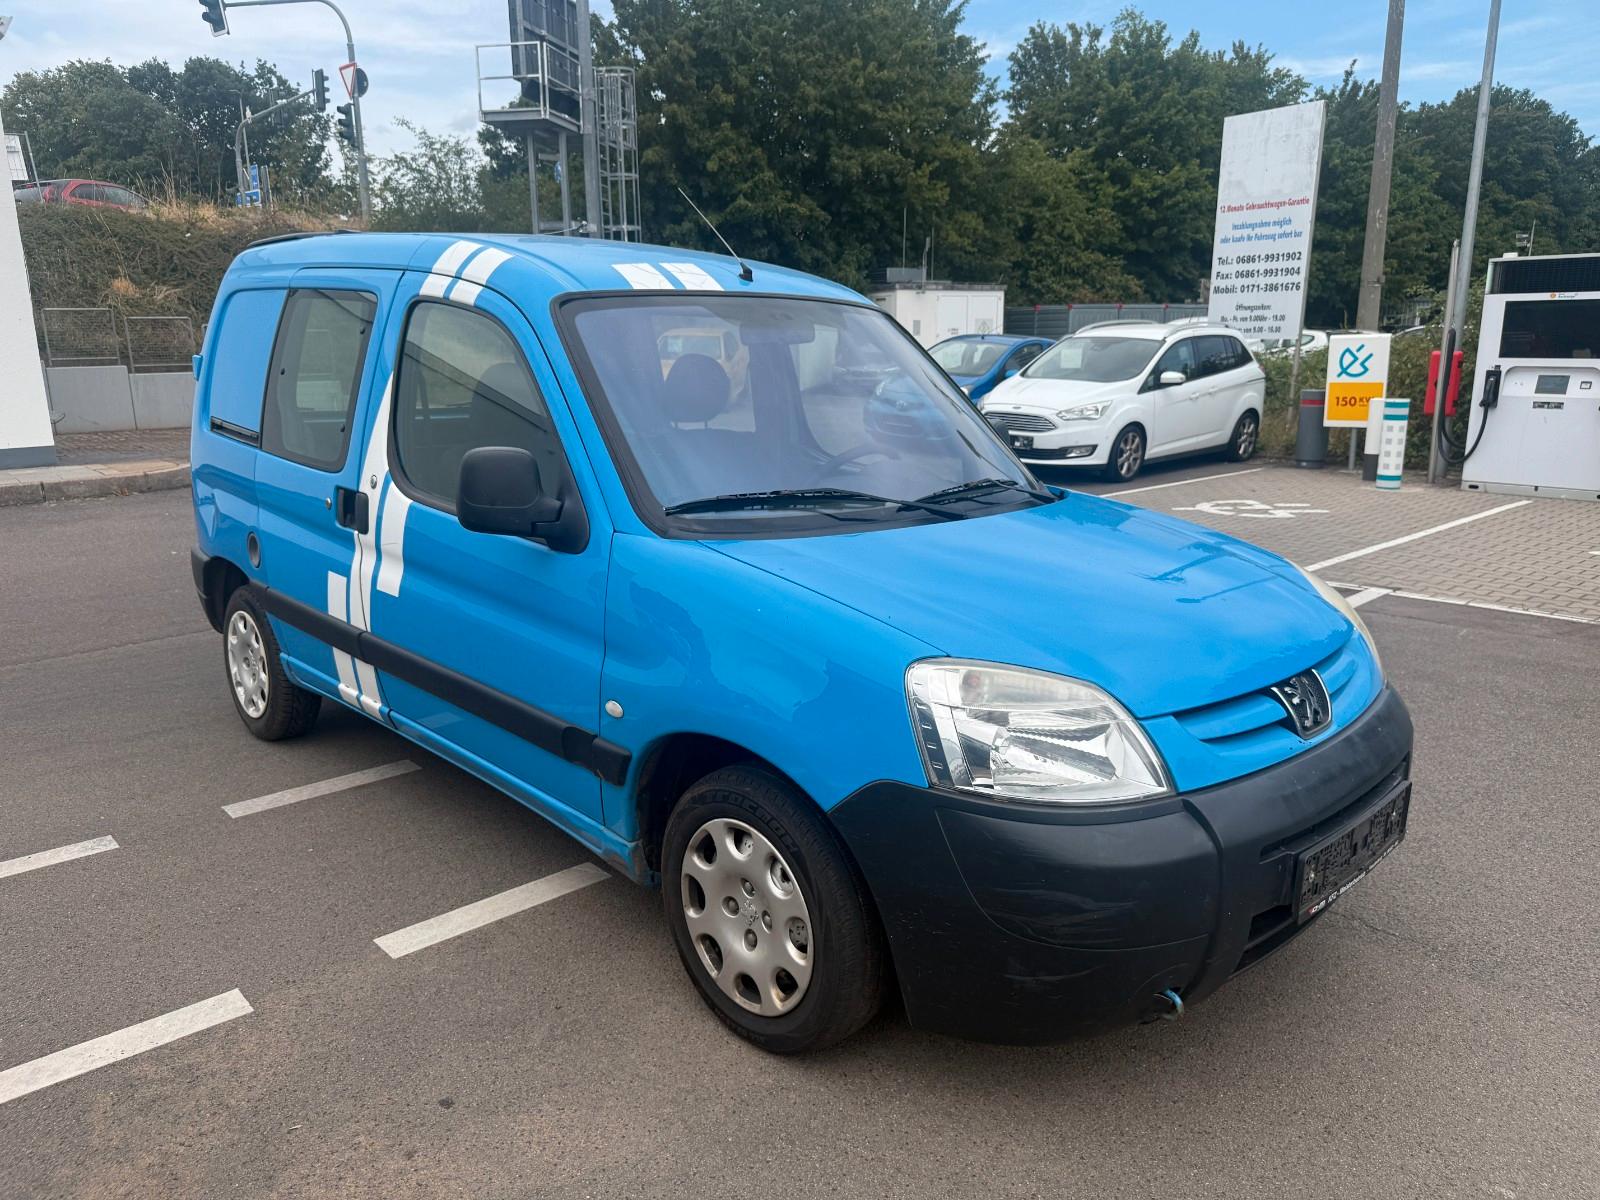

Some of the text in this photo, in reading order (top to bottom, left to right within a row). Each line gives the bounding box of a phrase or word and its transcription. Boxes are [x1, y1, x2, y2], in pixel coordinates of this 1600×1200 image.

[1217, 251, 1302, 266] Tel.: 06861-9931902
[1215, 267, 1301, 281] Fax: 06861-9931904
[1213, 282, 1301, 295] Mobil: 0171-3861676
[1335, 396, 1357, 407] 150
